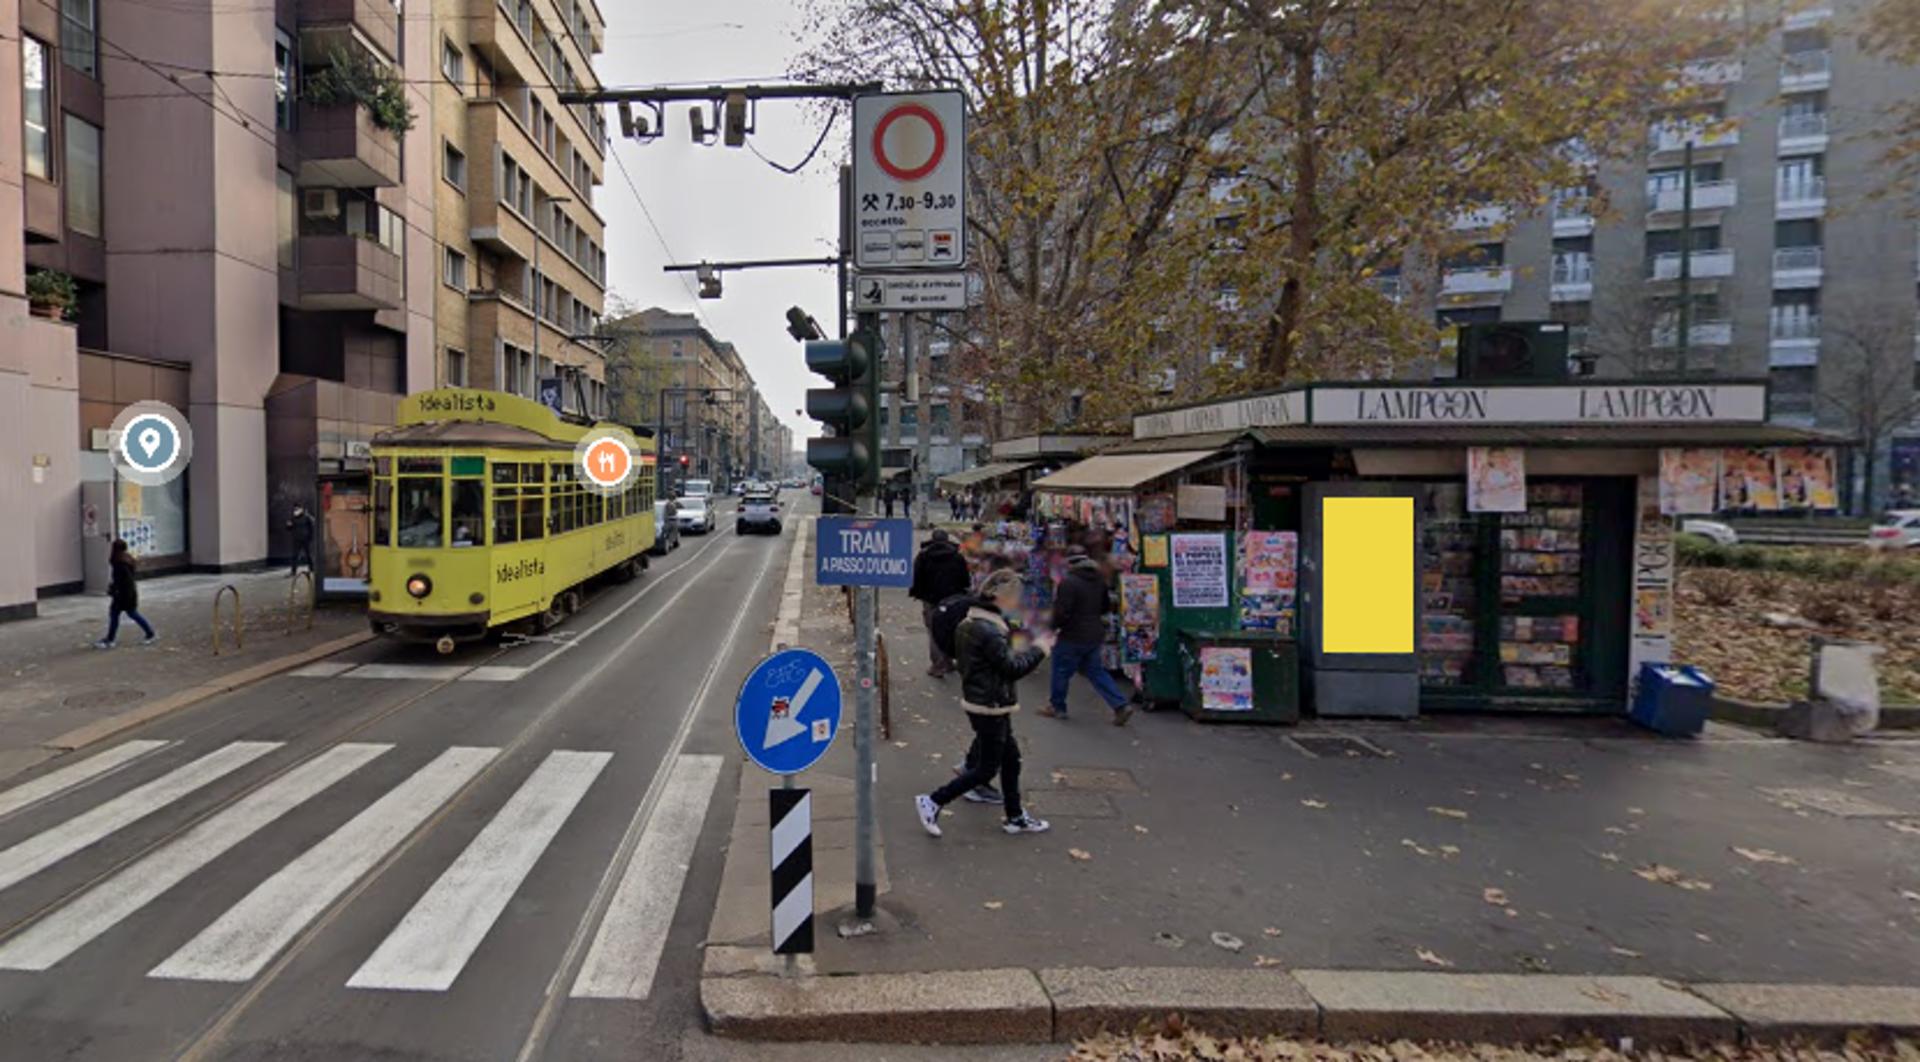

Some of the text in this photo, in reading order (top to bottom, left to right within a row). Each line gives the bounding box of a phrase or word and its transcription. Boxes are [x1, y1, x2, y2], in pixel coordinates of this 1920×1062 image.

[419, 392, 496, 412] idealista
[1357, 388, 1717, 420] LAMPOON LAMPOON
[838, 529, 890, 555] TRAM
[496, 557, 545, 584] idealista
[821, 556, 830, 572] A
[830, 556, 864, 574] PASSO
